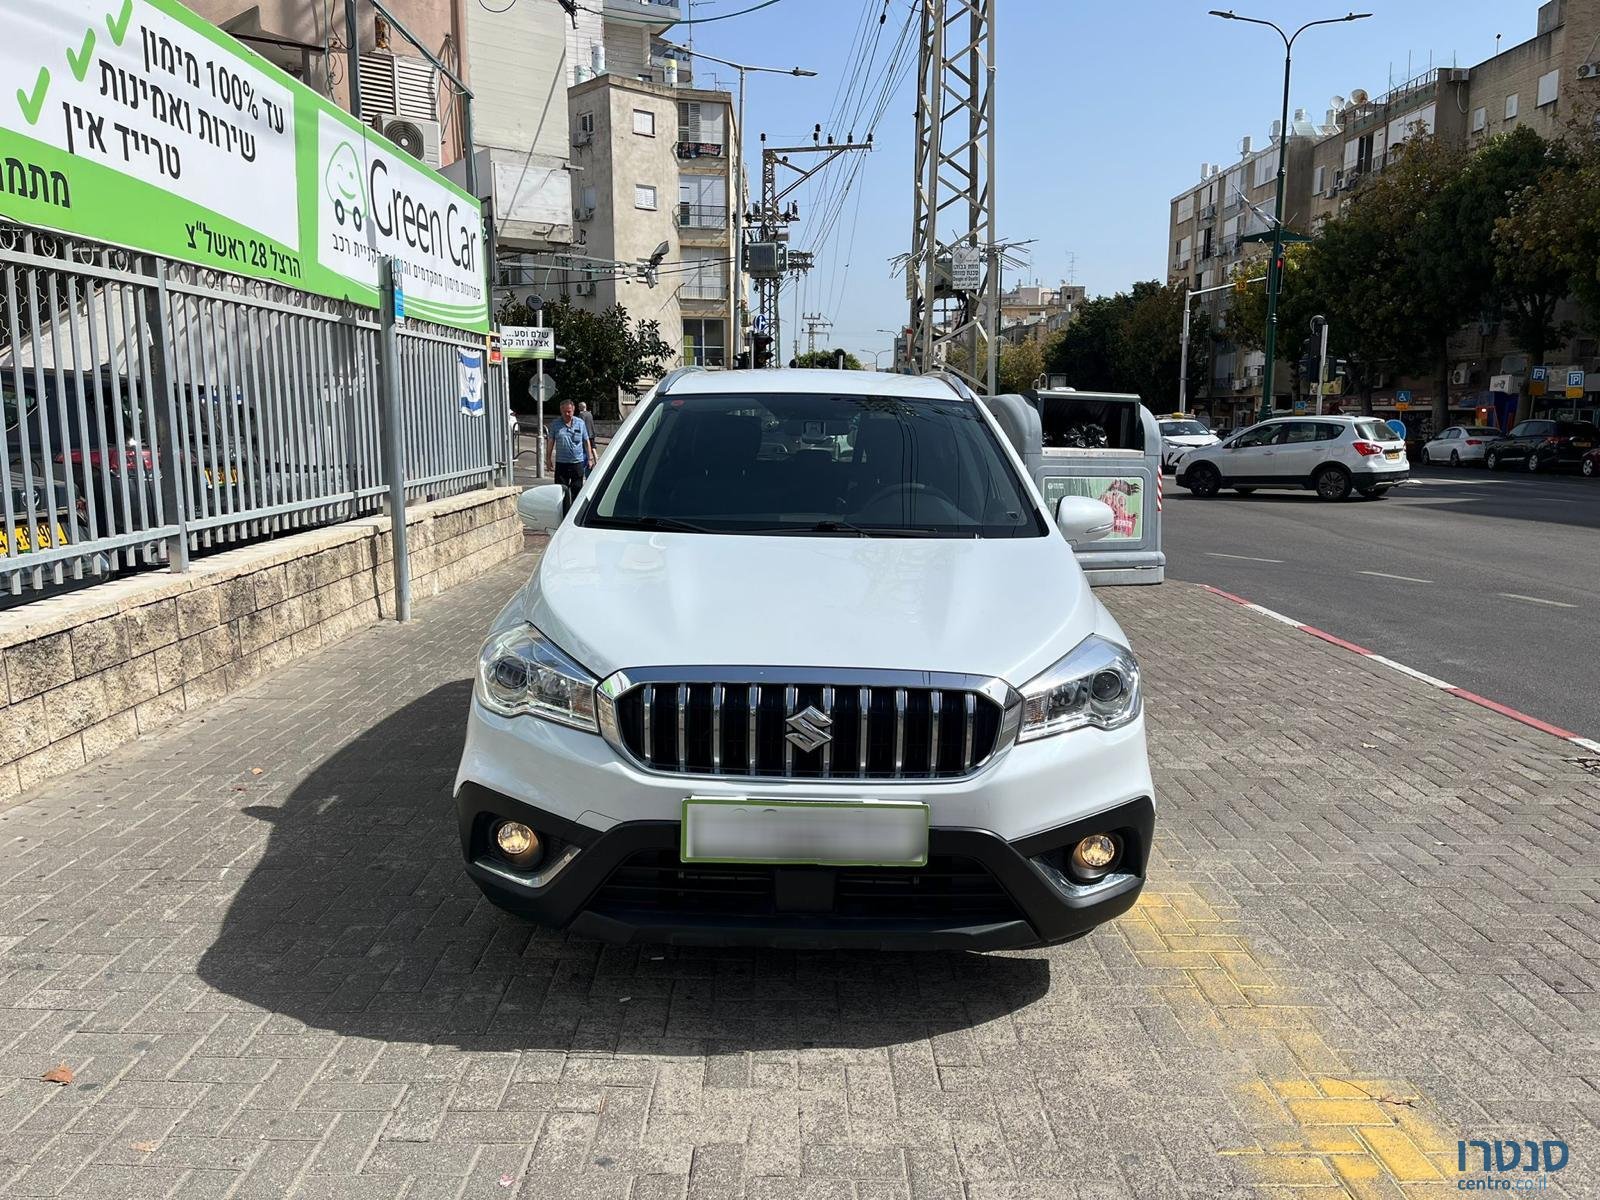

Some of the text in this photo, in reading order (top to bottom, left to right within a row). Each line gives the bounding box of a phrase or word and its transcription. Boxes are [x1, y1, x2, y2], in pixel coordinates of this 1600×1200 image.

[140, 25, 285, 135] עד 100% מימון
[98, 58, 256, 163] שירות ואמינות
[62, 101, 182, 180] טרייד אין
[370, 158, 477, 273] Green Car
[250, 240, 268, 269] 28
[332, 233, 351, 256] רכב
[269, 244, 301, 280] הרצל
[502, 339, 513, 347] קצ
[506, 330, 529, 338] וסע...
[527, 338, 550, 347] אצלנו
[530, 329, 549, 339] שלם
